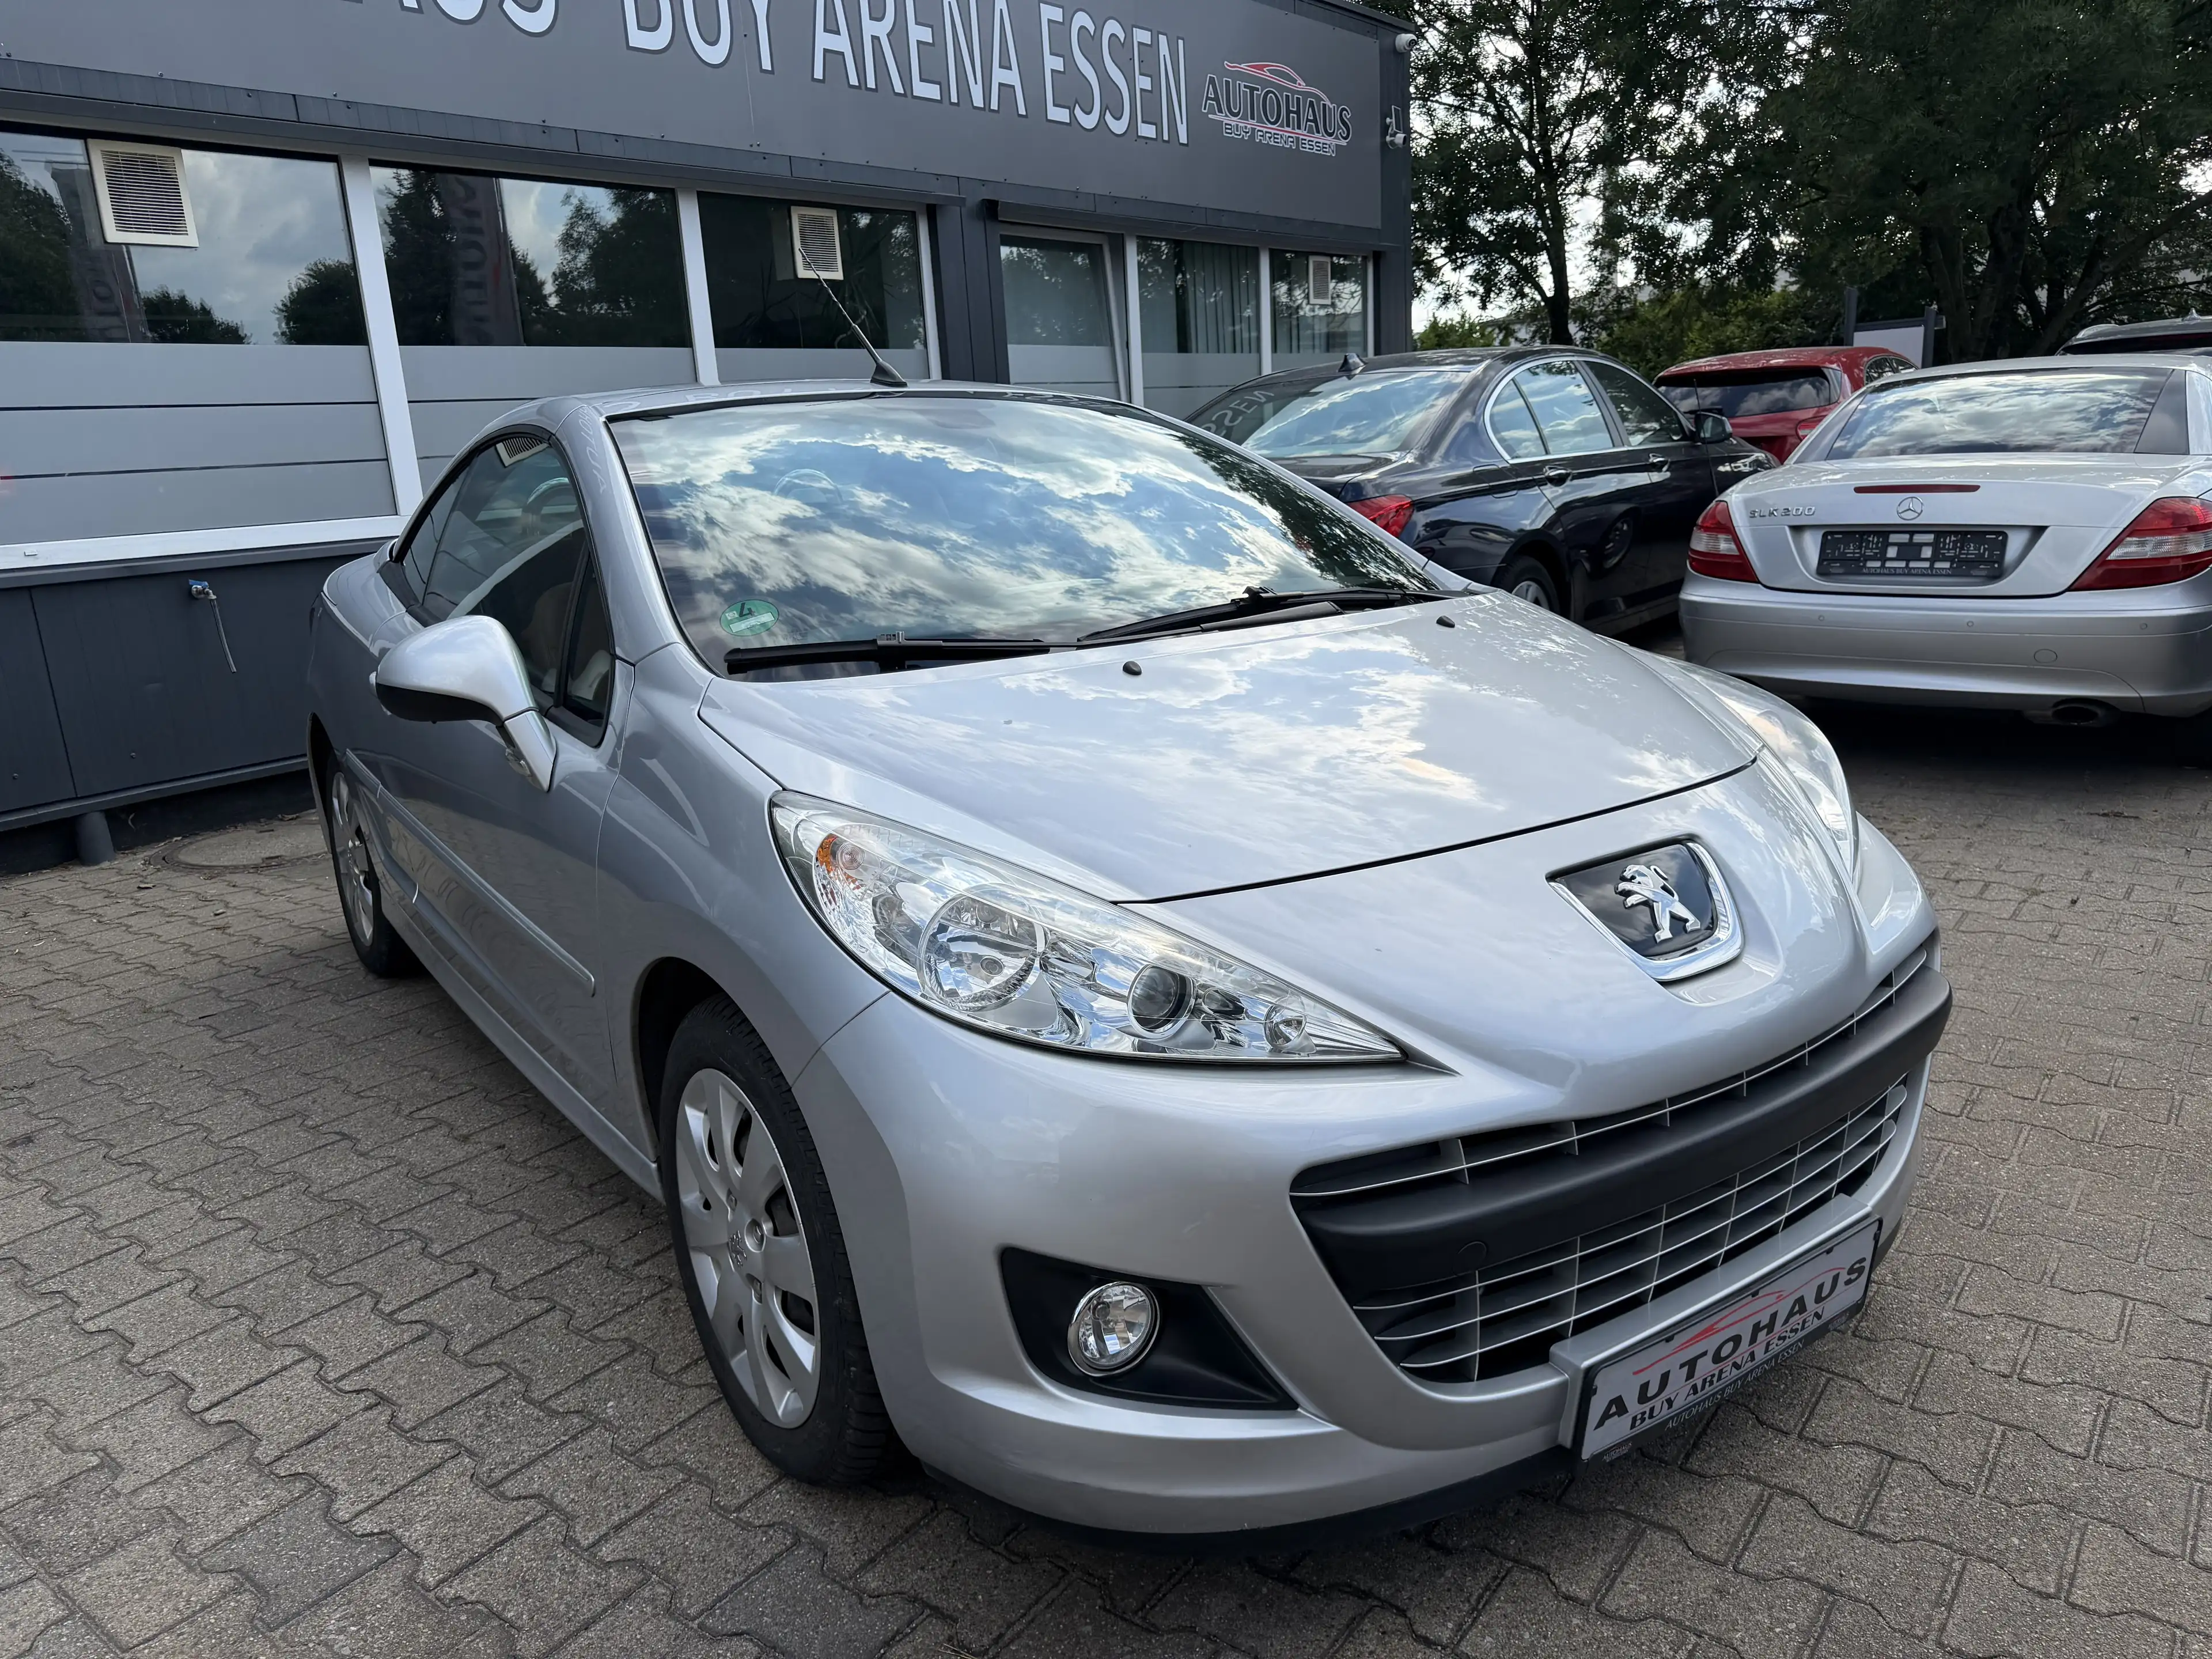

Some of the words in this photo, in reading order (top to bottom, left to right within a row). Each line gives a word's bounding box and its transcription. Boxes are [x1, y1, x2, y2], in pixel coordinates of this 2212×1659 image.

[813, 0, 1027, 116] ARENA
[1039, 4, 1188, 145] ESSEN
[1202, 74, 1352, 142] AUTOHAUS
[1223, 122, 1251, 139] BUY
[1255, 129, 1296, 149] ARENA
[1300, 138, 1335, 156] ESSEN
[1749, 507, 1778, 518] SLK
[1781, 506, 1816, 517] 200
[1593, 1257, 1866, 1431] AUTOHAUS
[1630, 1392, 1679, 1431] BUY
[1684, 1350, 1756, 1401] ARENA
[1764, 1305, 1824, 1355] ESSEN
[1665, 1391, 1722, 1431] AUTOHAUS
[1724, 1377, 1744, 1397] BUY
[1744, 1357, 1775, 1384] ARENA
[1778, 1339, 1804, 1363] ESSEN
